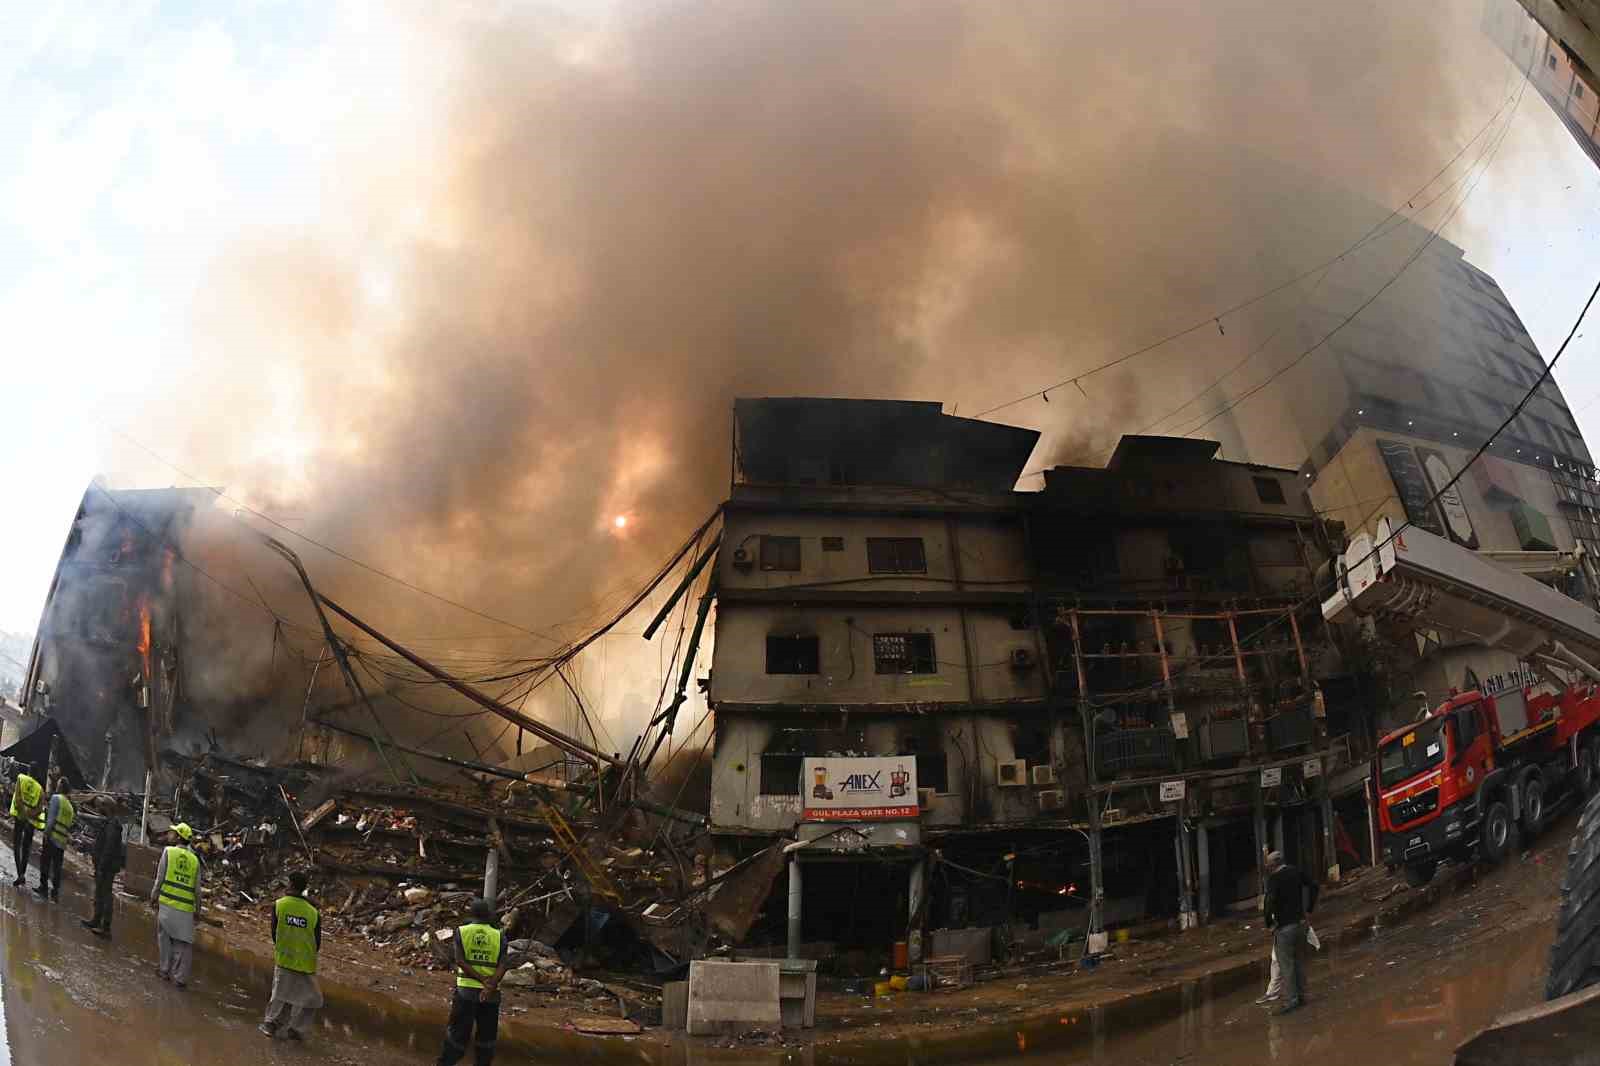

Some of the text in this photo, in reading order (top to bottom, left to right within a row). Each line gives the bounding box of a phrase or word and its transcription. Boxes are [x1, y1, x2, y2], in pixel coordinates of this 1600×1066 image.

[838, 769, 881, 792] ANEX
[812, 809, 830, 817] GUL
[832, 809, 860, 817] PLAZA
[861, 808, 883, 816] GATE
[287, 916, 306, 927] KMC
